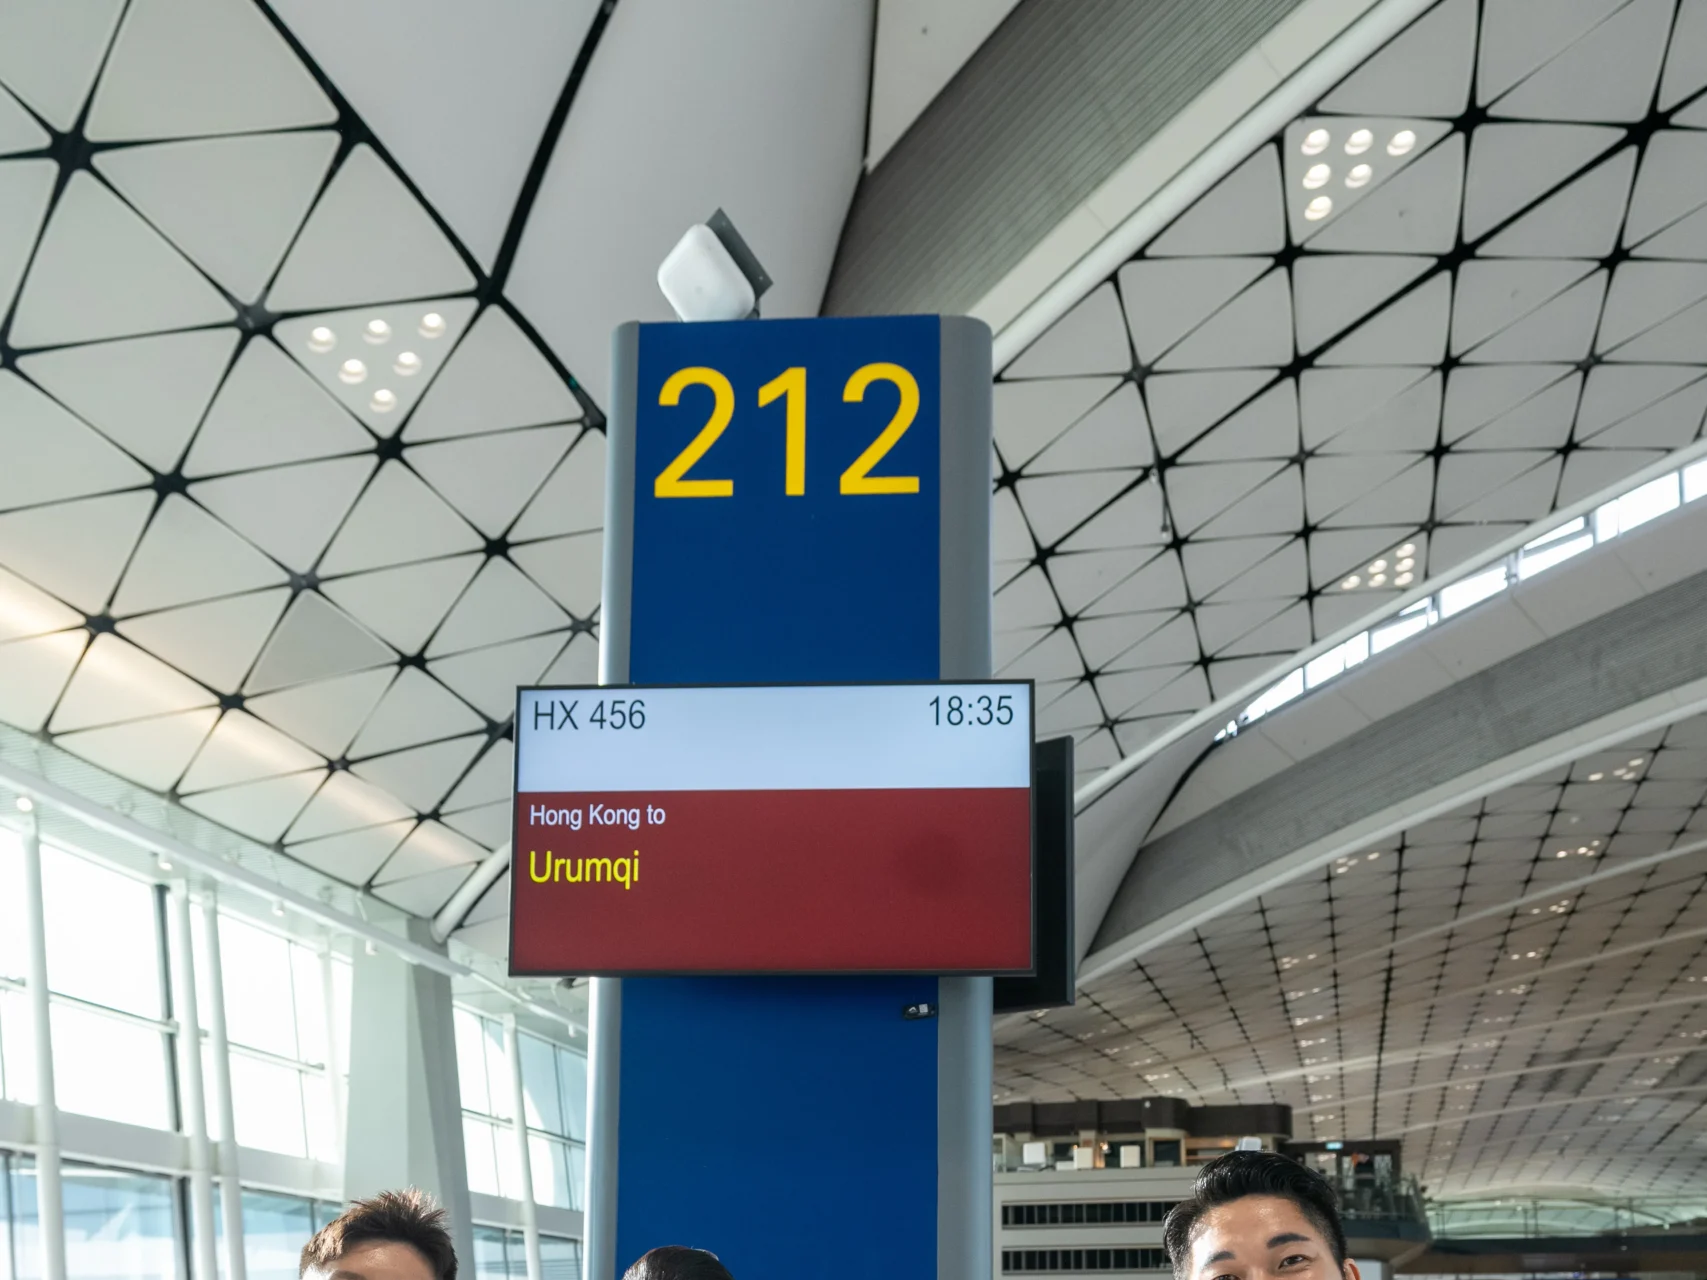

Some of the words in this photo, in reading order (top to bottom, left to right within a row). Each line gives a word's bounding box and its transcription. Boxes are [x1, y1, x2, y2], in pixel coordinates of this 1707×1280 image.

[654, 362, 920, 498] 212
[534, 700, 579, 730] HX
[589, 699, 646, 730] 456
[929, 695, 1014, 726] 18:35
[529, 804, 582, 831] Hong
[588, 803, 640, 830] Kong
[646, 804, 666, 825] to
[529, 850, 640, 890] Urumqi
